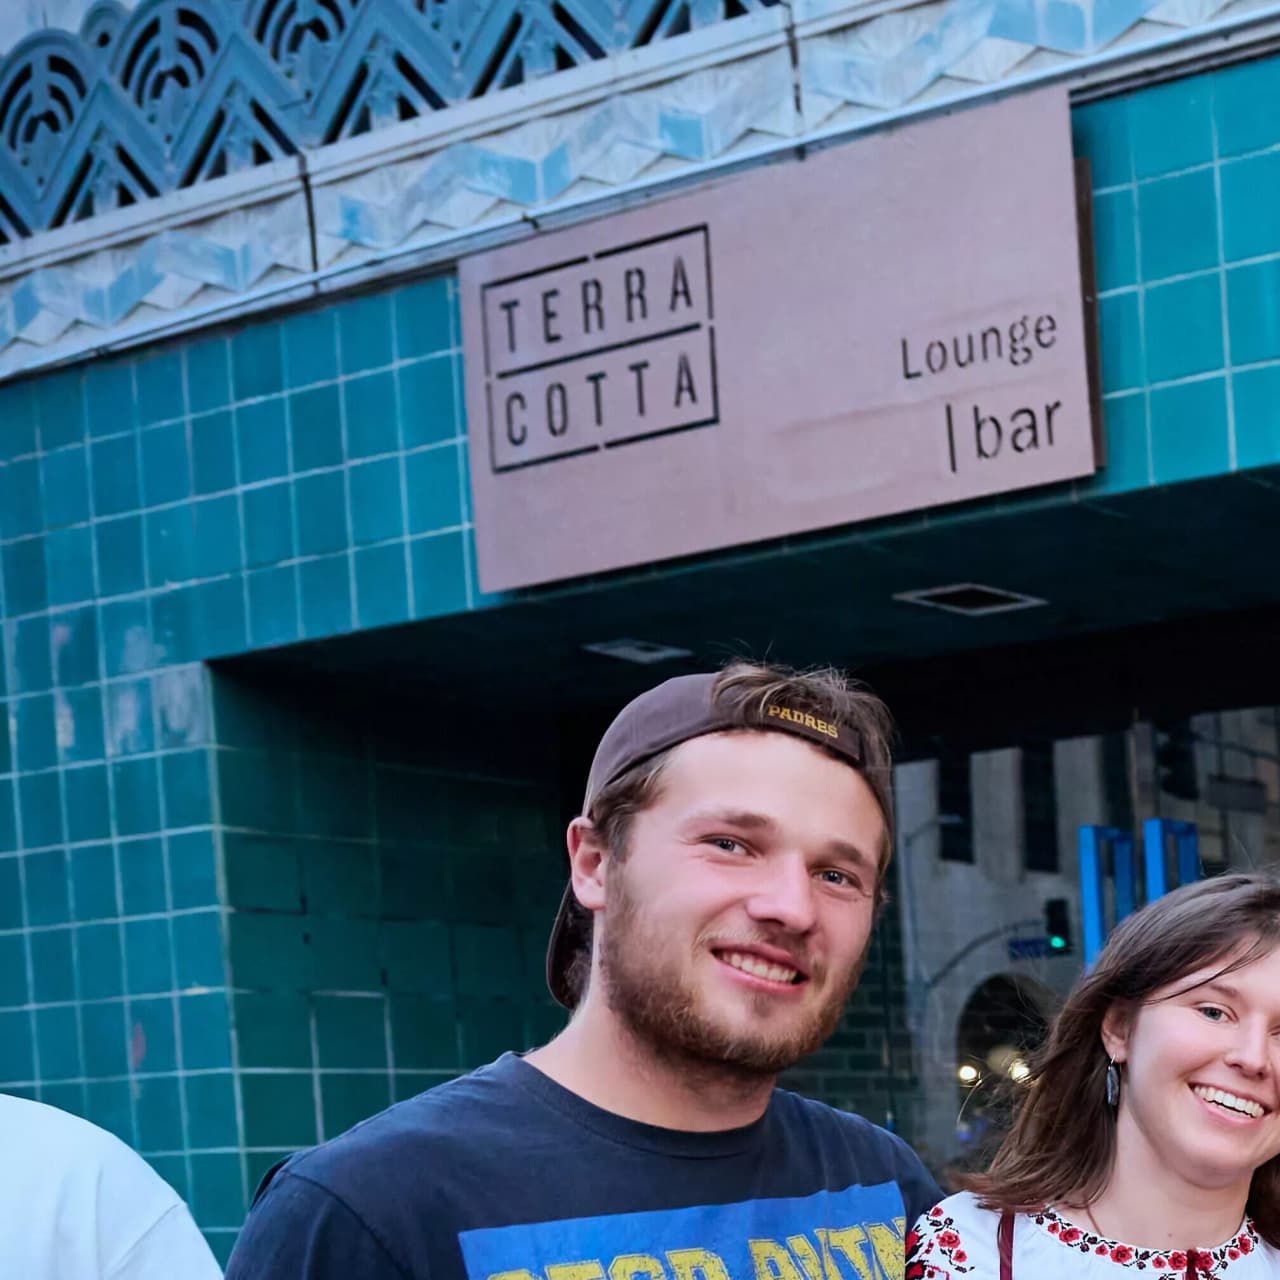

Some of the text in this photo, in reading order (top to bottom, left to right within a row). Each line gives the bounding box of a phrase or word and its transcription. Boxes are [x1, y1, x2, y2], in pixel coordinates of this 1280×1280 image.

[499, 255, 694, 354] TERRA
[901, 309, 1058, 381] Lounge
[504, 351, 698, 447] COTTA
[768, 704, 839, 739] PADRES
